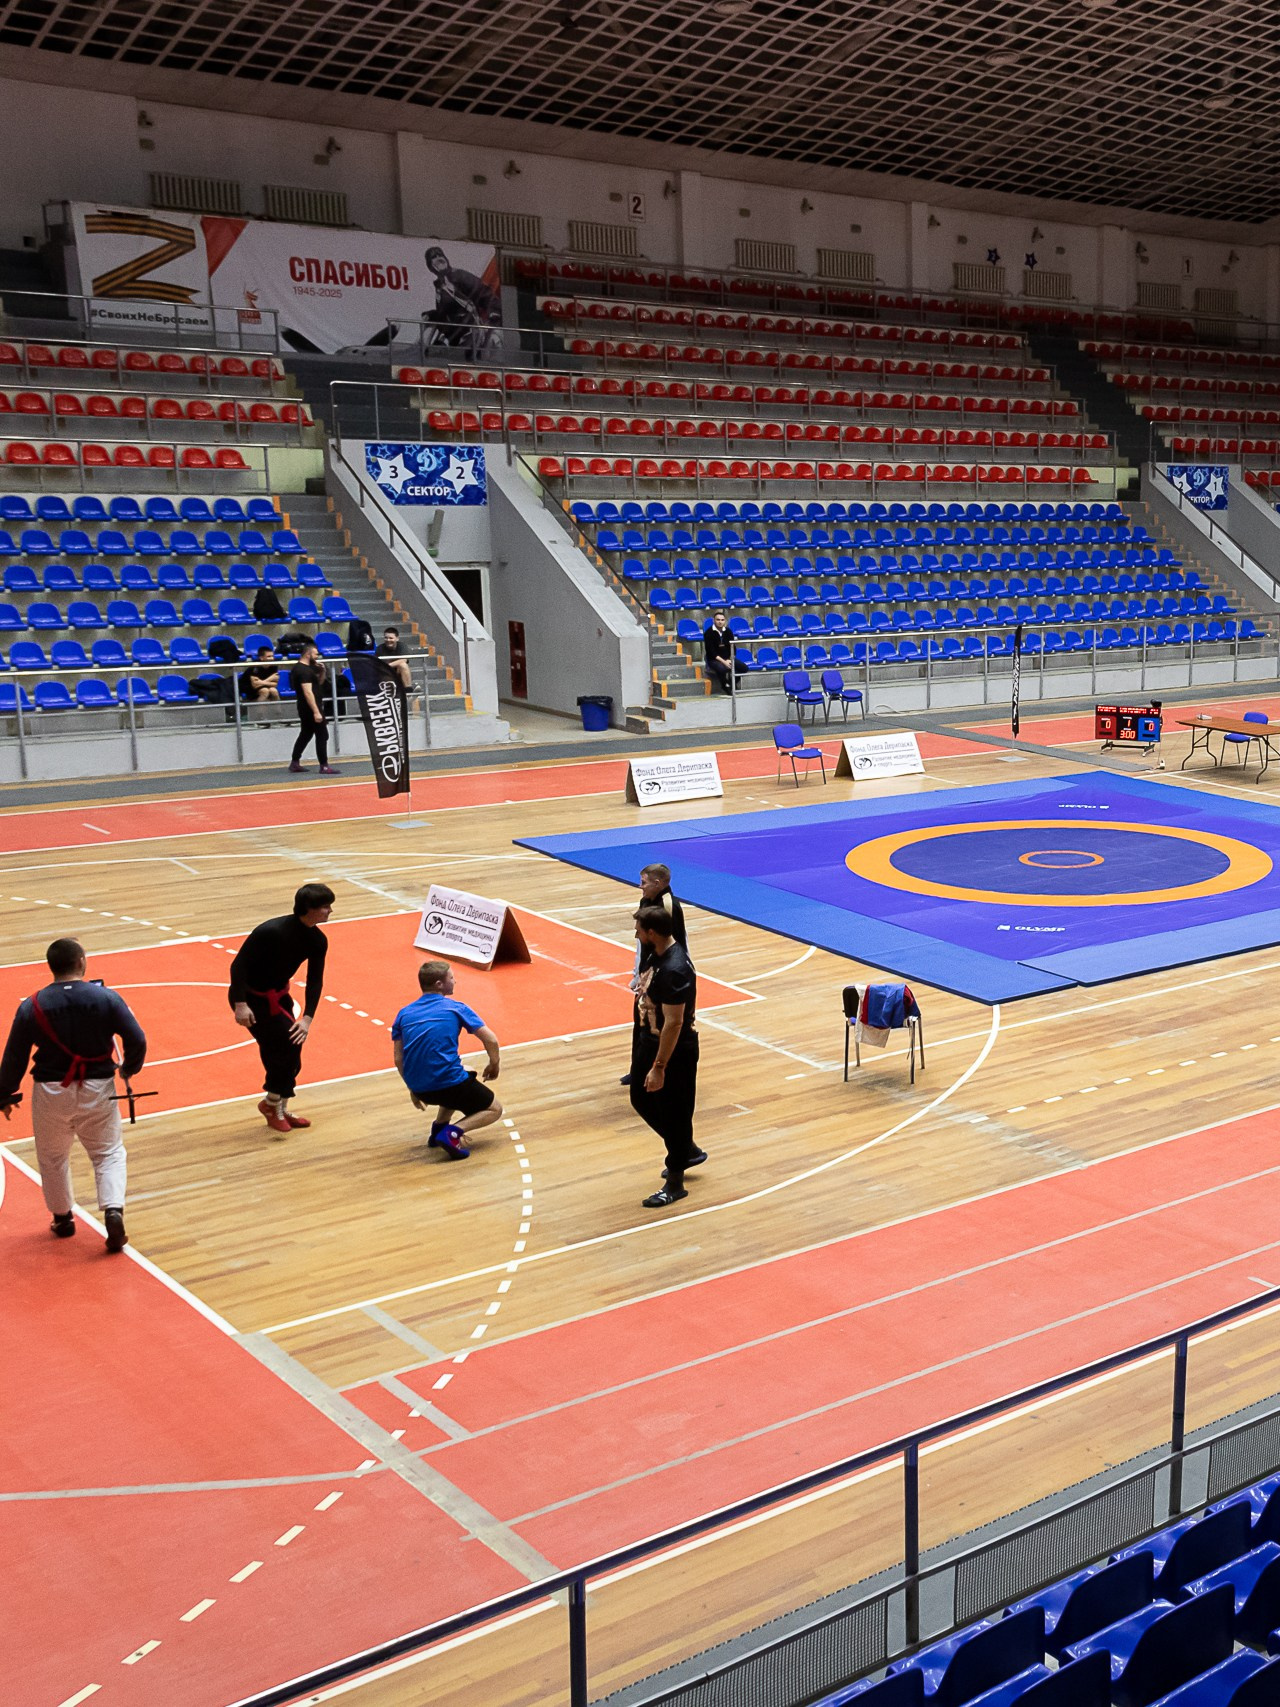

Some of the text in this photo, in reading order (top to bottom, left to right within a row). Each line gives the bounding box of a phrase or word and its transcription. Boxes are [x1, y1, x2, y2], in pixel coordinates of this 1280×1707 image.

[633, 196, 642, 214] 2
[1185, 259, 1190, 274] 1
[288, 256, 409, 291] СПАСИБО!
[293, 286, 343, 298] 1945-2025
[91, 308, 209, 326] #СвоихНеБросаем
[389, 466, 398, 478] 3
[456, 467, 465, 479] 2
[407, 486, 450, 496] СЕКТОР
[1178, 482, 1183, 492] 2
[1214, 482, 1217, 491] 1
[1149, 722, 1154, 731] 0
[635, 762, 713, 777] Фонд Олега Дерипаска
[431, 895, 499, 924] Фонд Олега Дерипаска
[444, 920, 494, 942] Развитие медицины
